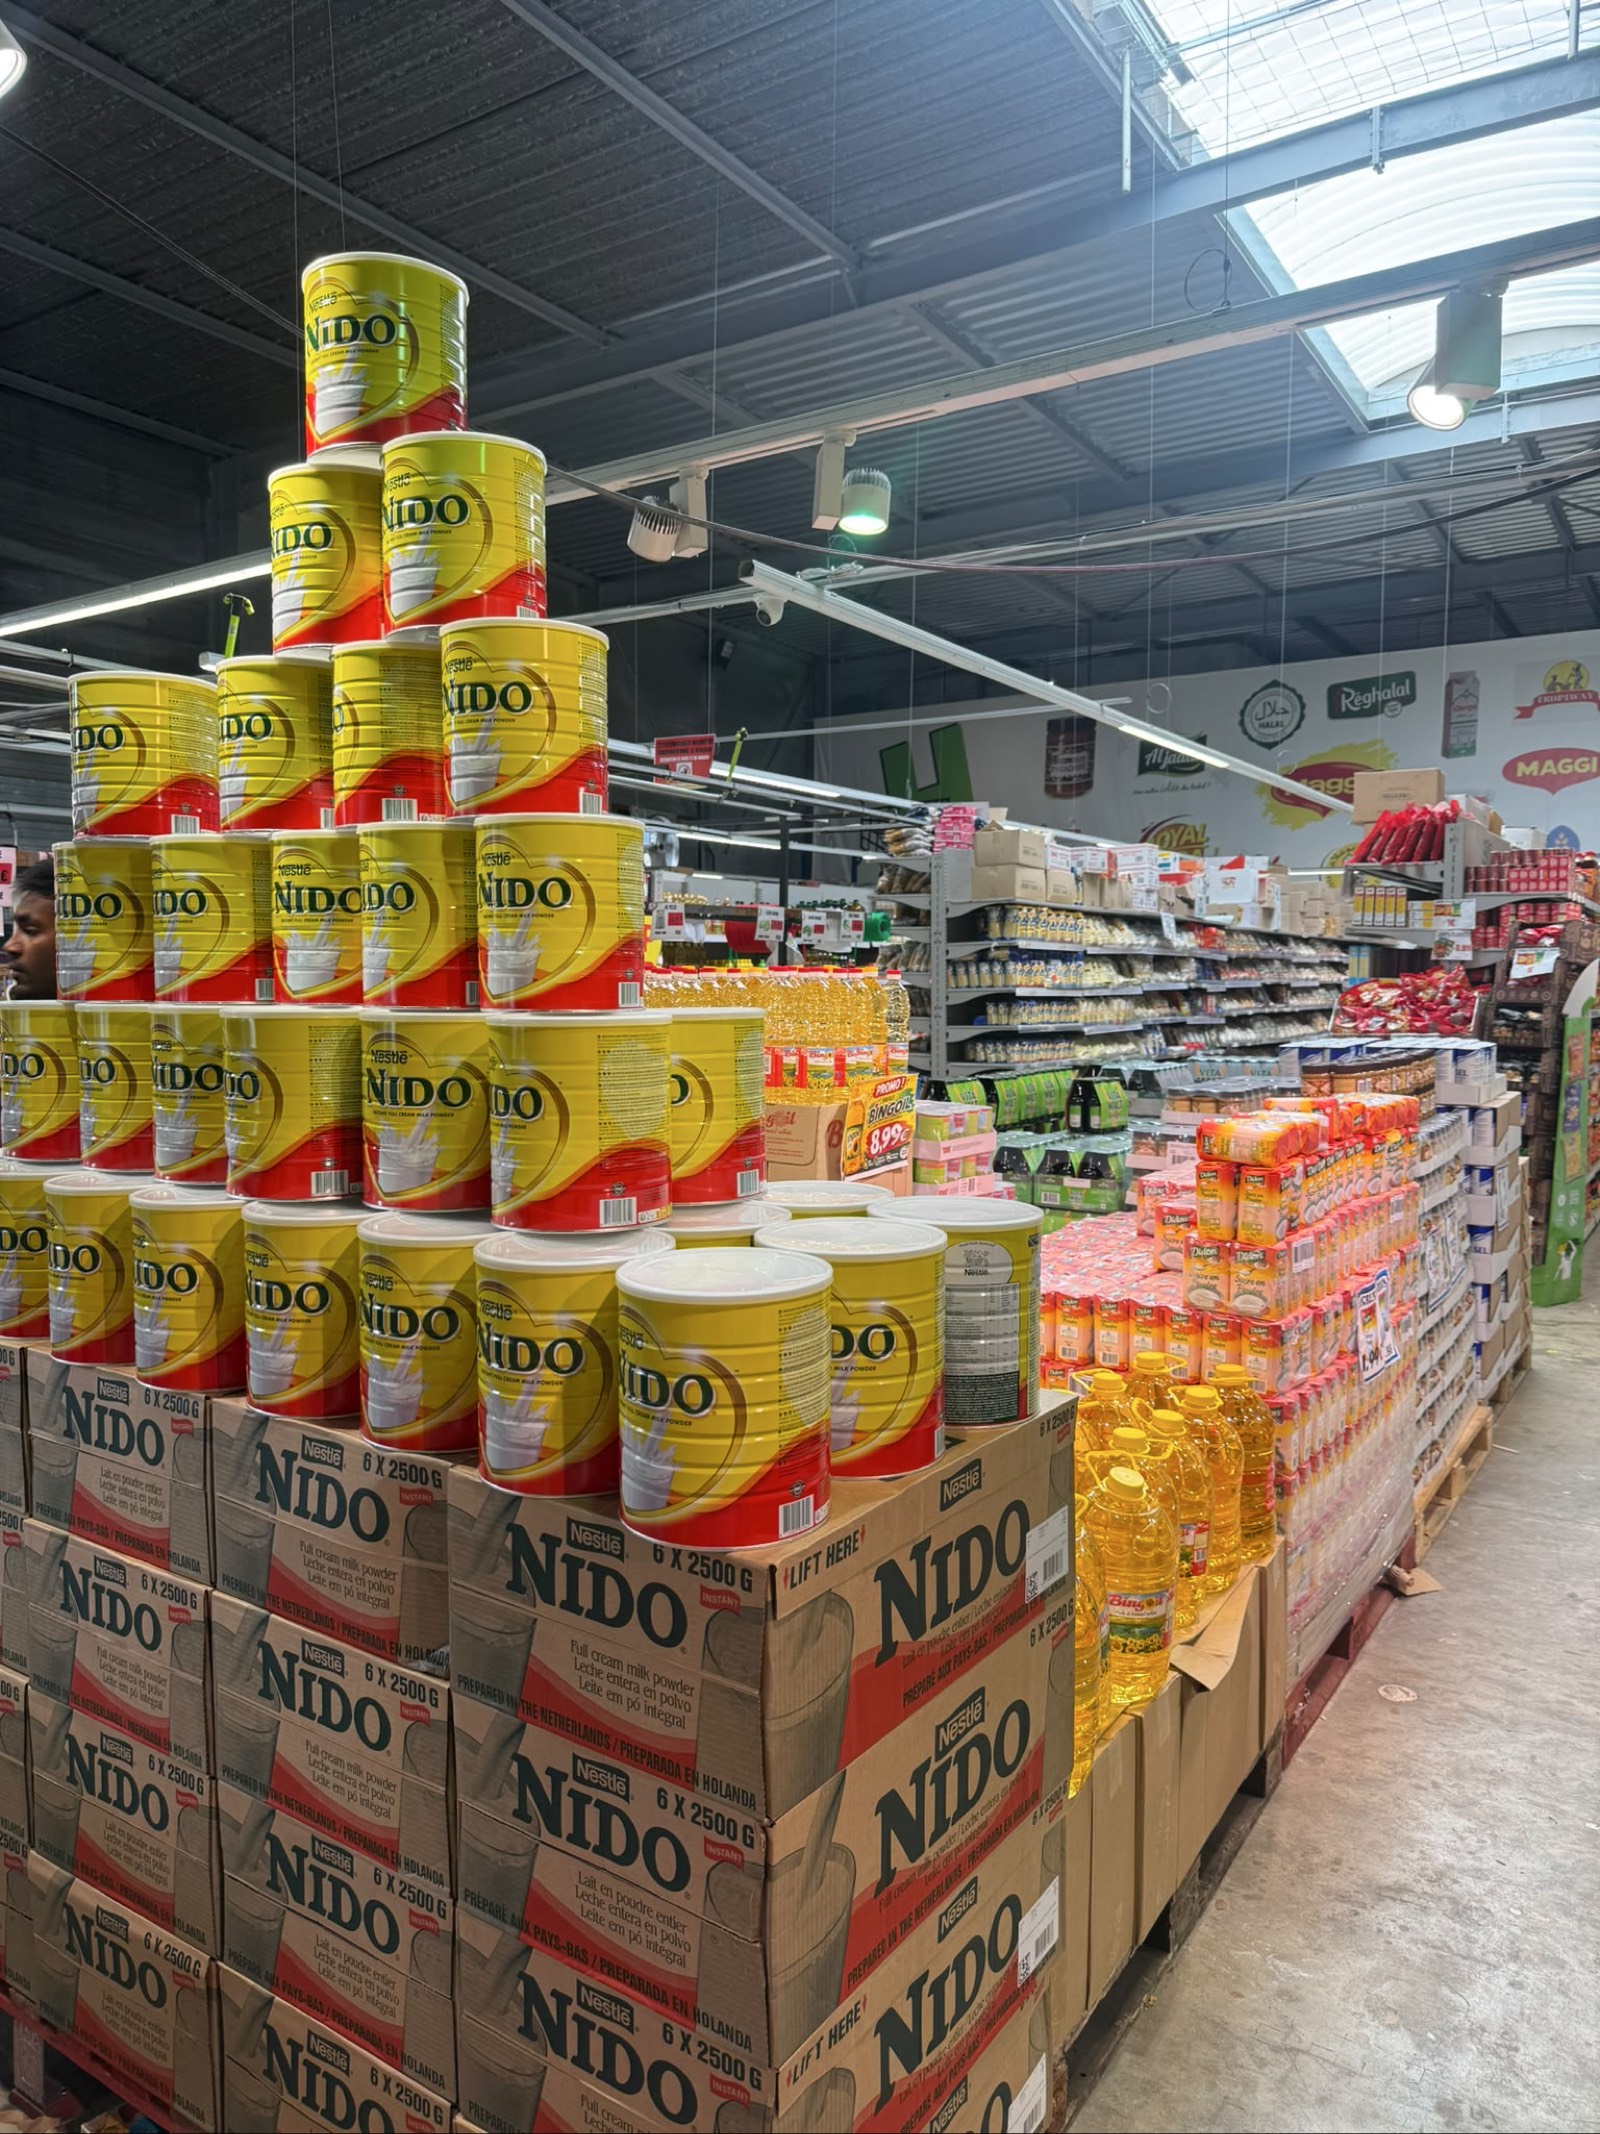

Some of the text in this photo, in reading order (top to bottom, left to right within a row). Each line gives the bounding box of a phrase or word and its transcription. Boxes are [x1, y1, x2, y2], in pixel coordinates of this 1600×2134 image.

[306, 314, 395, 352] NIDO
[1340, 678, 1410, 712] Réghalal
[1517, 757, 1598, 777] MAGGI
[1150, 824, 1208, 849] OYAL
[478, 871, 572, 910] NIDO
[371, 1050, 408, 1065] Nestlé
[367, 1067, 472, 1108] NIDO
[868, 1096, 911, 1124] BINGOIL
[875, 1079, 900, 1096] PROMO
[1191, 1247, 1217, 1257] Didon
[1237, 1251, 1263, 1260] Didon
[360, 1291, 460, 1342] NIDO
[478, 1322, 585, 1375] NIDO
[100, 1384, 128, 1402] Nestlé
[145, 1390, 199, 1419] 6 X 2500 G
[63, 1386, 165, 1466] NIDO
[304, 1440, 342, 1467] Nestlé
[363, 1452, 443, 1489] 6 X 2500 G
[255, 1442, 390, 1543] NIDO
[943, 1466, 979, 1503] Nestlé
[300, 1540, 398, 1581] Full cream milk powder
[571, 1522, 621, 1556] Nestlé
[789, 1528, 860, 1590] LIFT HERE
[96, 1560, 125, 1584] Nestlé
[505, 1522, 688, 1648] NIDO
[653, 1543, 753, 1593] 6 X 2500 G
[874, 1500, 1030, 1668] NIDO
[60, 1560, 162, 1651] NIDO
[141, 1573, 198, 1610] 6 X 2500 G
[702, 1592, 739, 1609] INSTANT
[1030, 1629, 1036, 1648] 6
[1038, 1626, 1045, 1641] X
[1046, 1609, 1067, 1637] 2500
[305, 1644, 343, 1672] Nestlé
[570, 1640, 695, 1697] Full cream milk powder
[903, 1672, 935, 1708] PRÉPARÉ
[938, 1660, 950, 1681] AUX
[953, 1633, 988, 1671] PAYS-BAS
[257, 1640, 392, 1751] NIDO
[365, 1662, 439, 1709] 6 X 2500 G
[574, 1657, 692, 1713] Leche entera en polvo
[579, 1675, 686, 1730] Leite em pó integral
[457, 1674, 505, 1704] PREPARED
[507, 1693, 518, 1708] IN
[520, 1700, 538, 1721] THE
[540, 1706, 612, 1752] NETHERLANDS
[620, 1740, 682, 1780] PREPARADA
[685, 1763, 699, 1785] EN
[702, 1772, 757, 1811] HOLANDA
[939, 1701, 983, 1752] Nestlé
[66, 1734, 170, 1831] NIDO
[148, 1754, 204, 1795] 6 X 2500 G
[576, 1760, 626, 1796] Nestlé
[512, 1752, 691, 1892] NIDO
[656, 1786, 755, 1849] 6 X 2500 G
[874, 1699, 1031, 1899] NIDO
[315, 1840, 352, 1873] Nestlé
[706, 1842, 743, 1864] INSTANT
[266, 1832, 400, 1954] NIDO
[373, 1864, 447, 1920] 6 X 2500 G
[941, 1890, 975, 1936] Nestlé
[63, 1903, 168, 2009] NIDO
[144, 1932, 151, 1950] 6
[165, 1944, 192, 1974] 2500
[193, 1959, 201, 1979] G
[580, 1987, 632, 2028] Nestlé
[873, 1893, 1022, 2117] NIDO
[311, 2035, 348, 2071] Nestlé
[517, 1971, 698, 2125] NIDO
[662, 2022, 762, 2091] 6 X 2500 G
[791, 2010, 862, 2086] LIFT HERE
[263, 2022, 395, 2134] NIDO
[370, 2066, 444, 2123] 6 X 2500 G
[712, 2080, 750, 2102] INSTANT
